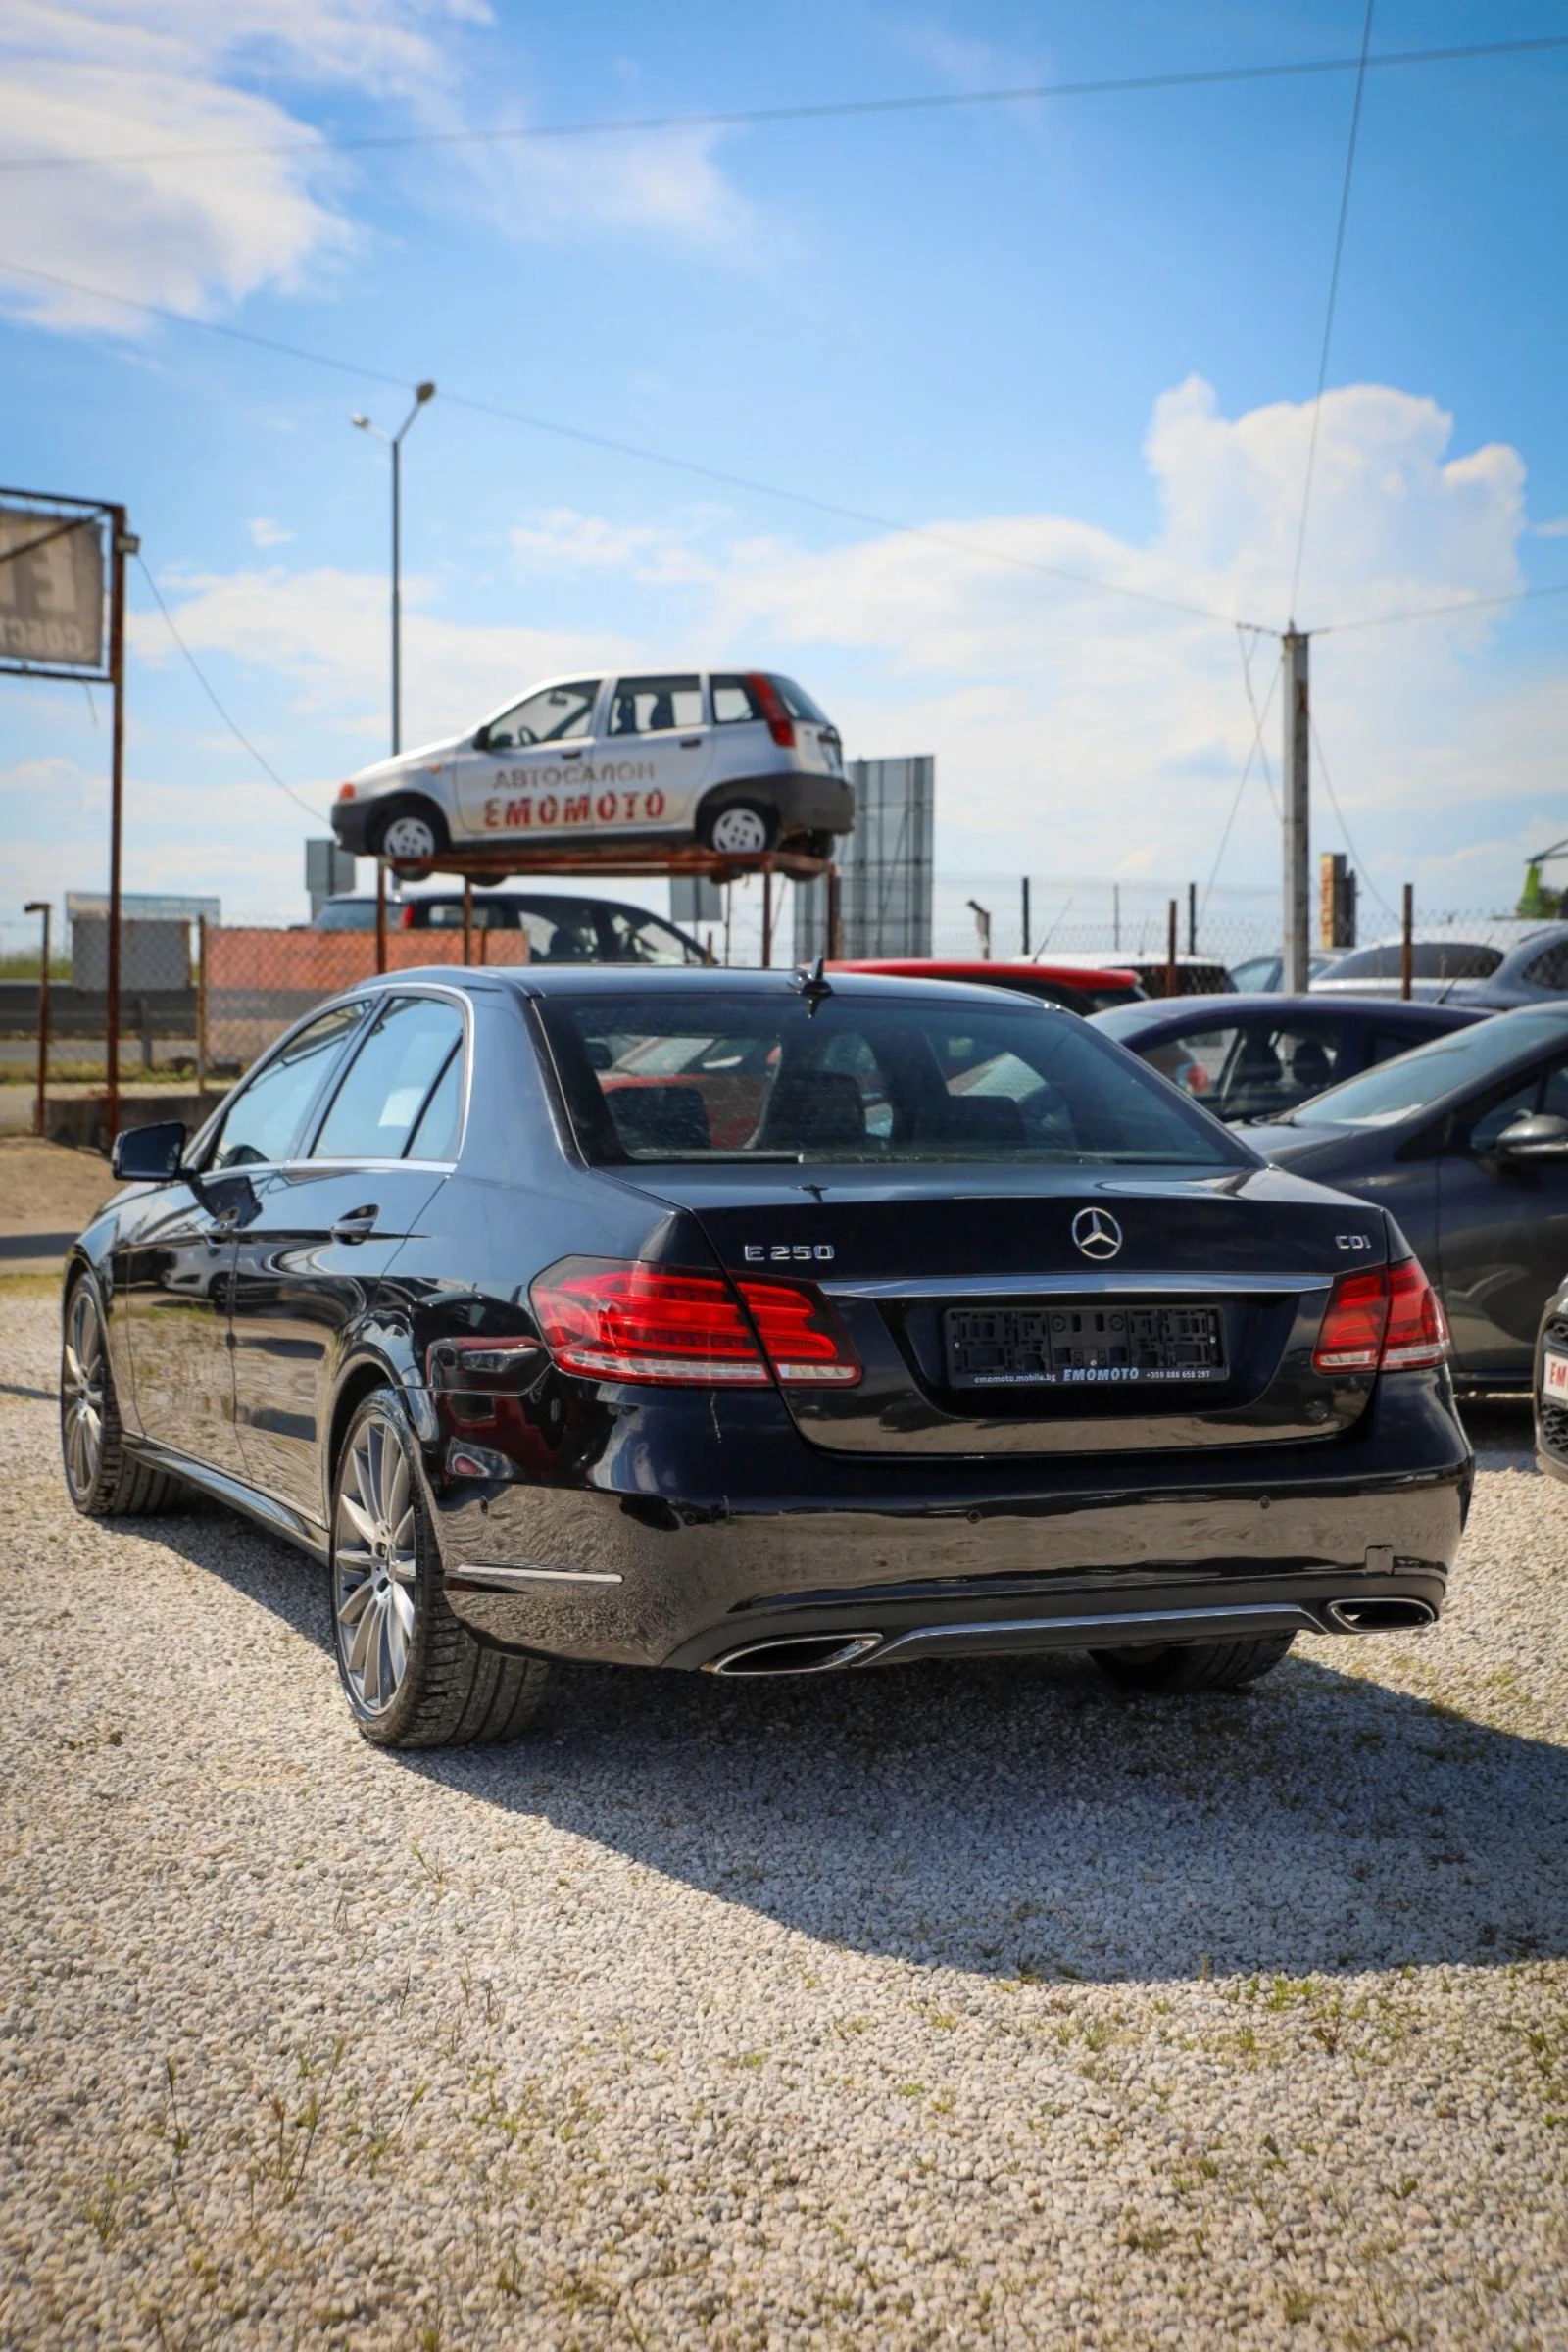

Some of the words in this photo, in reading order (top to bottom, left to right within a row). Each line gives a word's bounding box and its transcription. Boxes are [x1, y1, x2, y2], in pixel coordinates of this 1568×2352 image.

[493, 760, 655, 789] АВТОСАЛОН
[483, 788, 665, 828] EMOMOTO
[1335, 1235, 1372, 1250] CDI
[744, 1245, 765, 1261] E
[770, 1245, 835, 1260] 250
[1063, 1367, 1140, 1382] EMOMOTO
